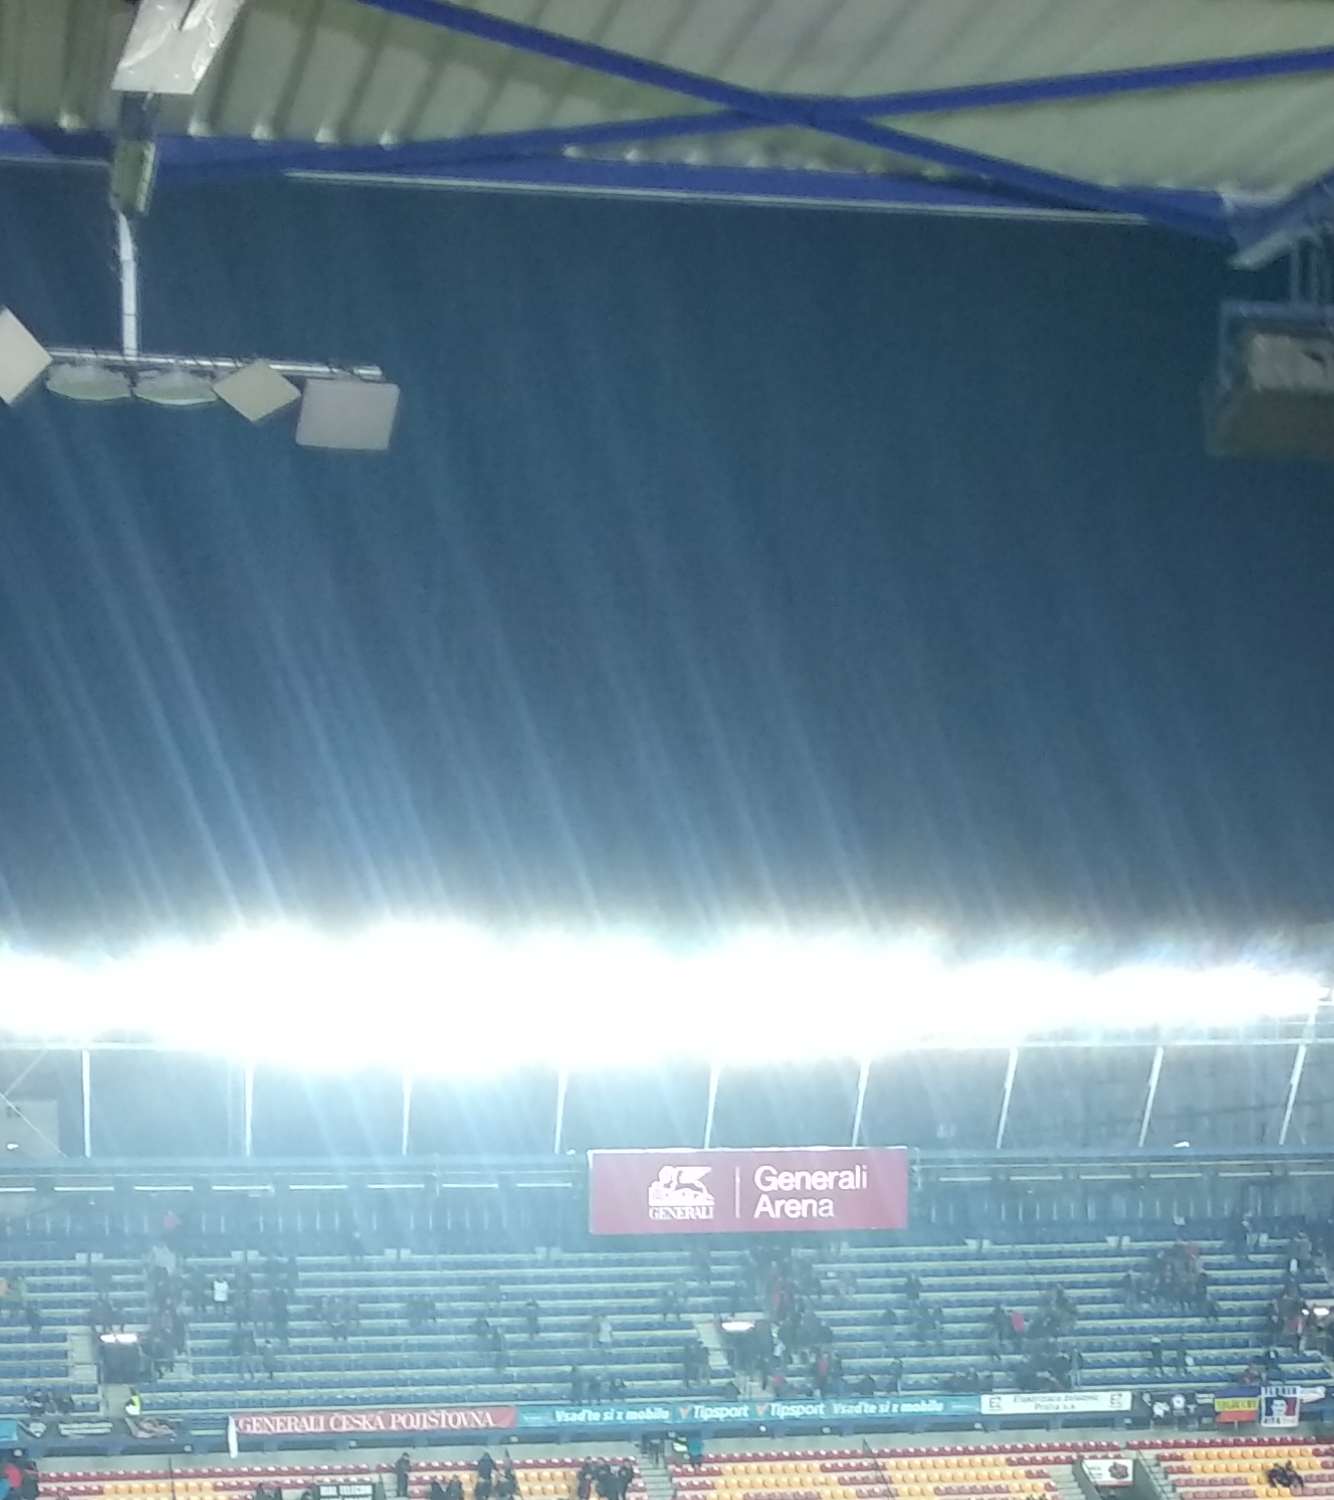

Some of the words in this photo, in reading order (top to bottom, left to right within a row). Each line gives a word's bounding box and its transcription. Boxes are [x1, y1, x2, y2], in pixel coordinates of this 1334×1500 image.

[753, 1165, 868, 1192] Generali
[648, 1206, 714, 1220] GENERALI
[753, 1194, 835, 1219] Arena
[692, 1404, 751, 1420] Tipsport
[769, 1402, 826, 1418] Tipsport
[238, 1415, 326, 1434] GENERALI
[328, 1411, 385, 1431] ČESKÁ
[389, 1408, 495, 1431] POJIŠŤOVNA
